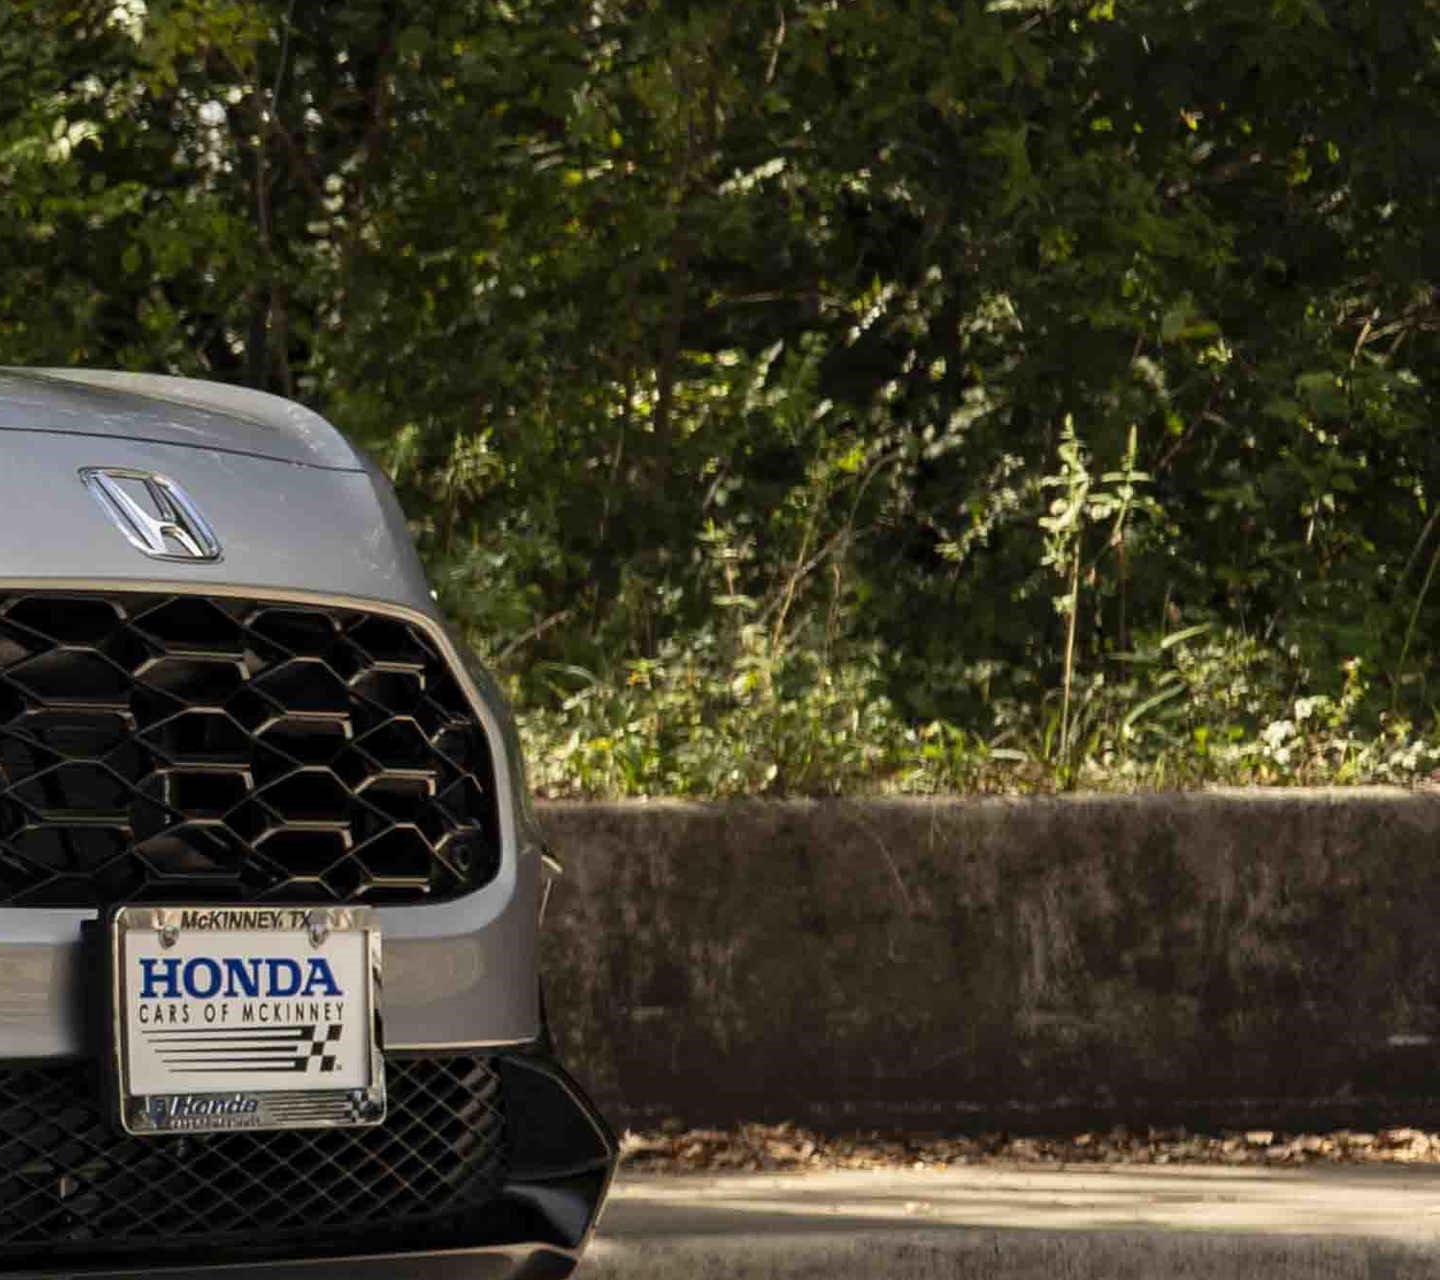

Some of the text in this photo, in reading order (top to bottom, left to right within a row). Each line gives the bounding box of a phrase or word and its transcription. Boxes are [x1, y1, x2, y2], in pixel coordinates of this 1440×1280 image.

[138, 957, 344, 999] HONDA
[138, 1001, 344, 1024] CARS OF MCKINNEY
